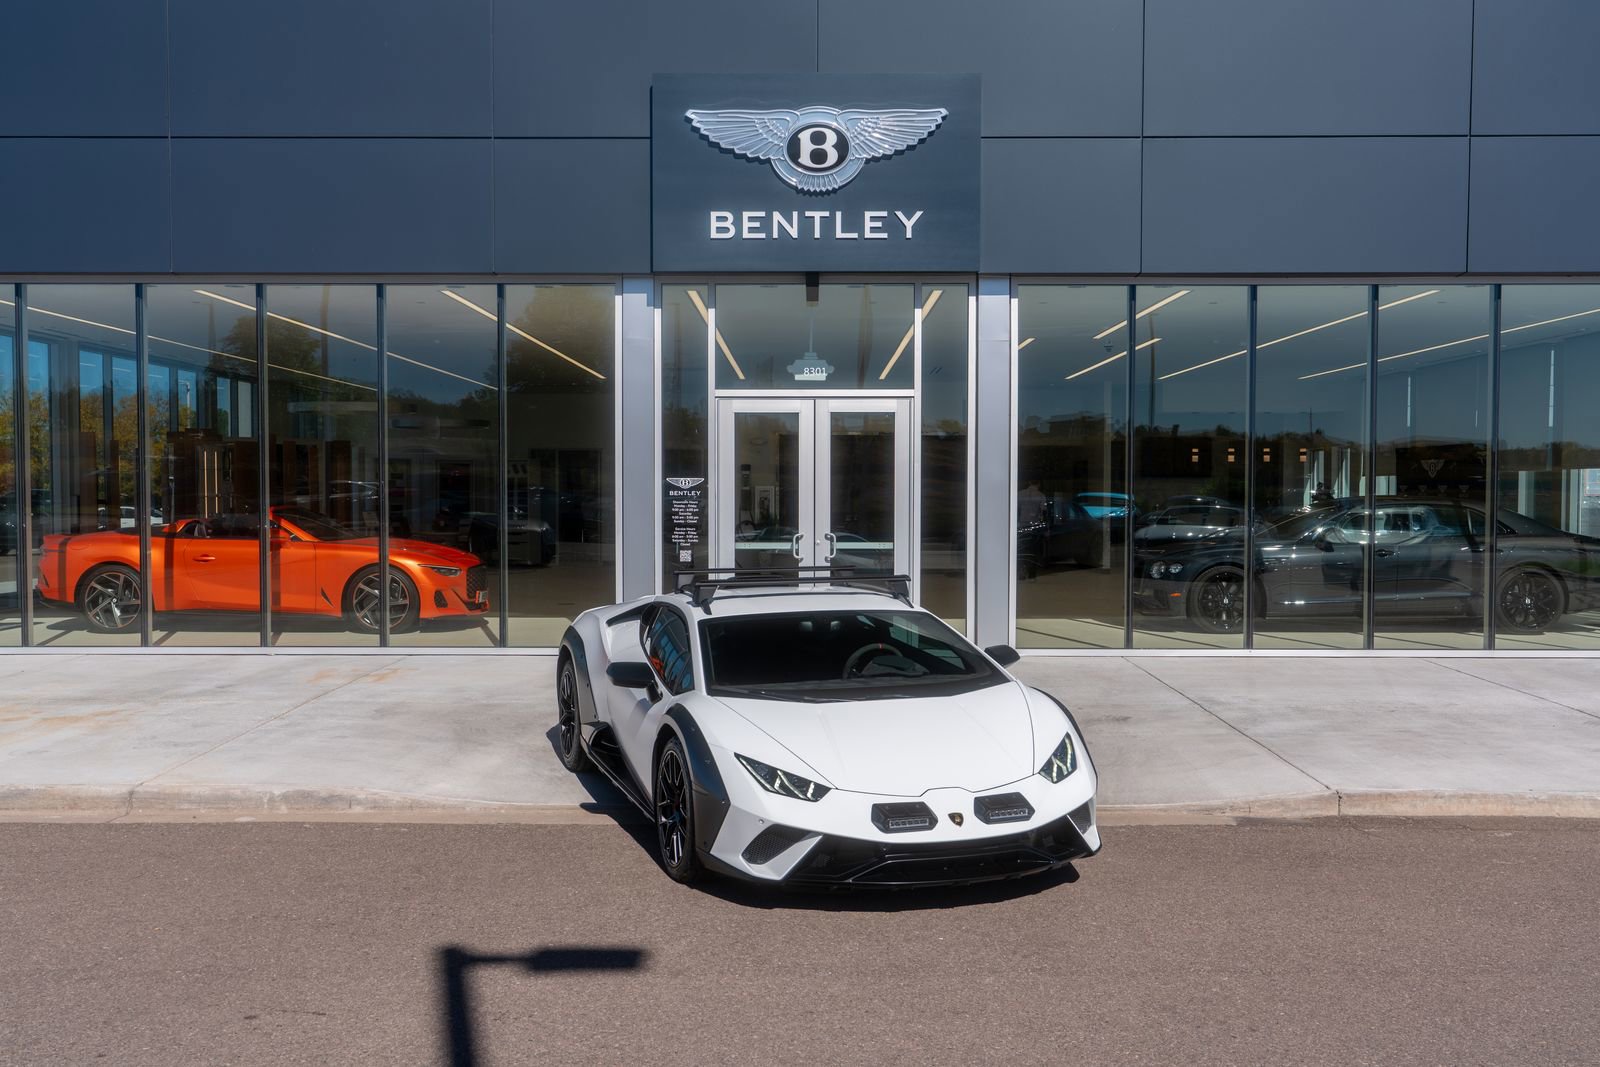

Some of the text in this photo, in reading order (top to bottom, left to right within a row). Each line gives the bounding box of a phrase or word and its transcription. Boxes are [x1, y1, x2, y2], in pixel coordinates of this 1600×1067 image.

[798, 127, 838, 168] B
[710, 211, 923, 239] BENTLEY
[804, 368, 826, 376] 8301
